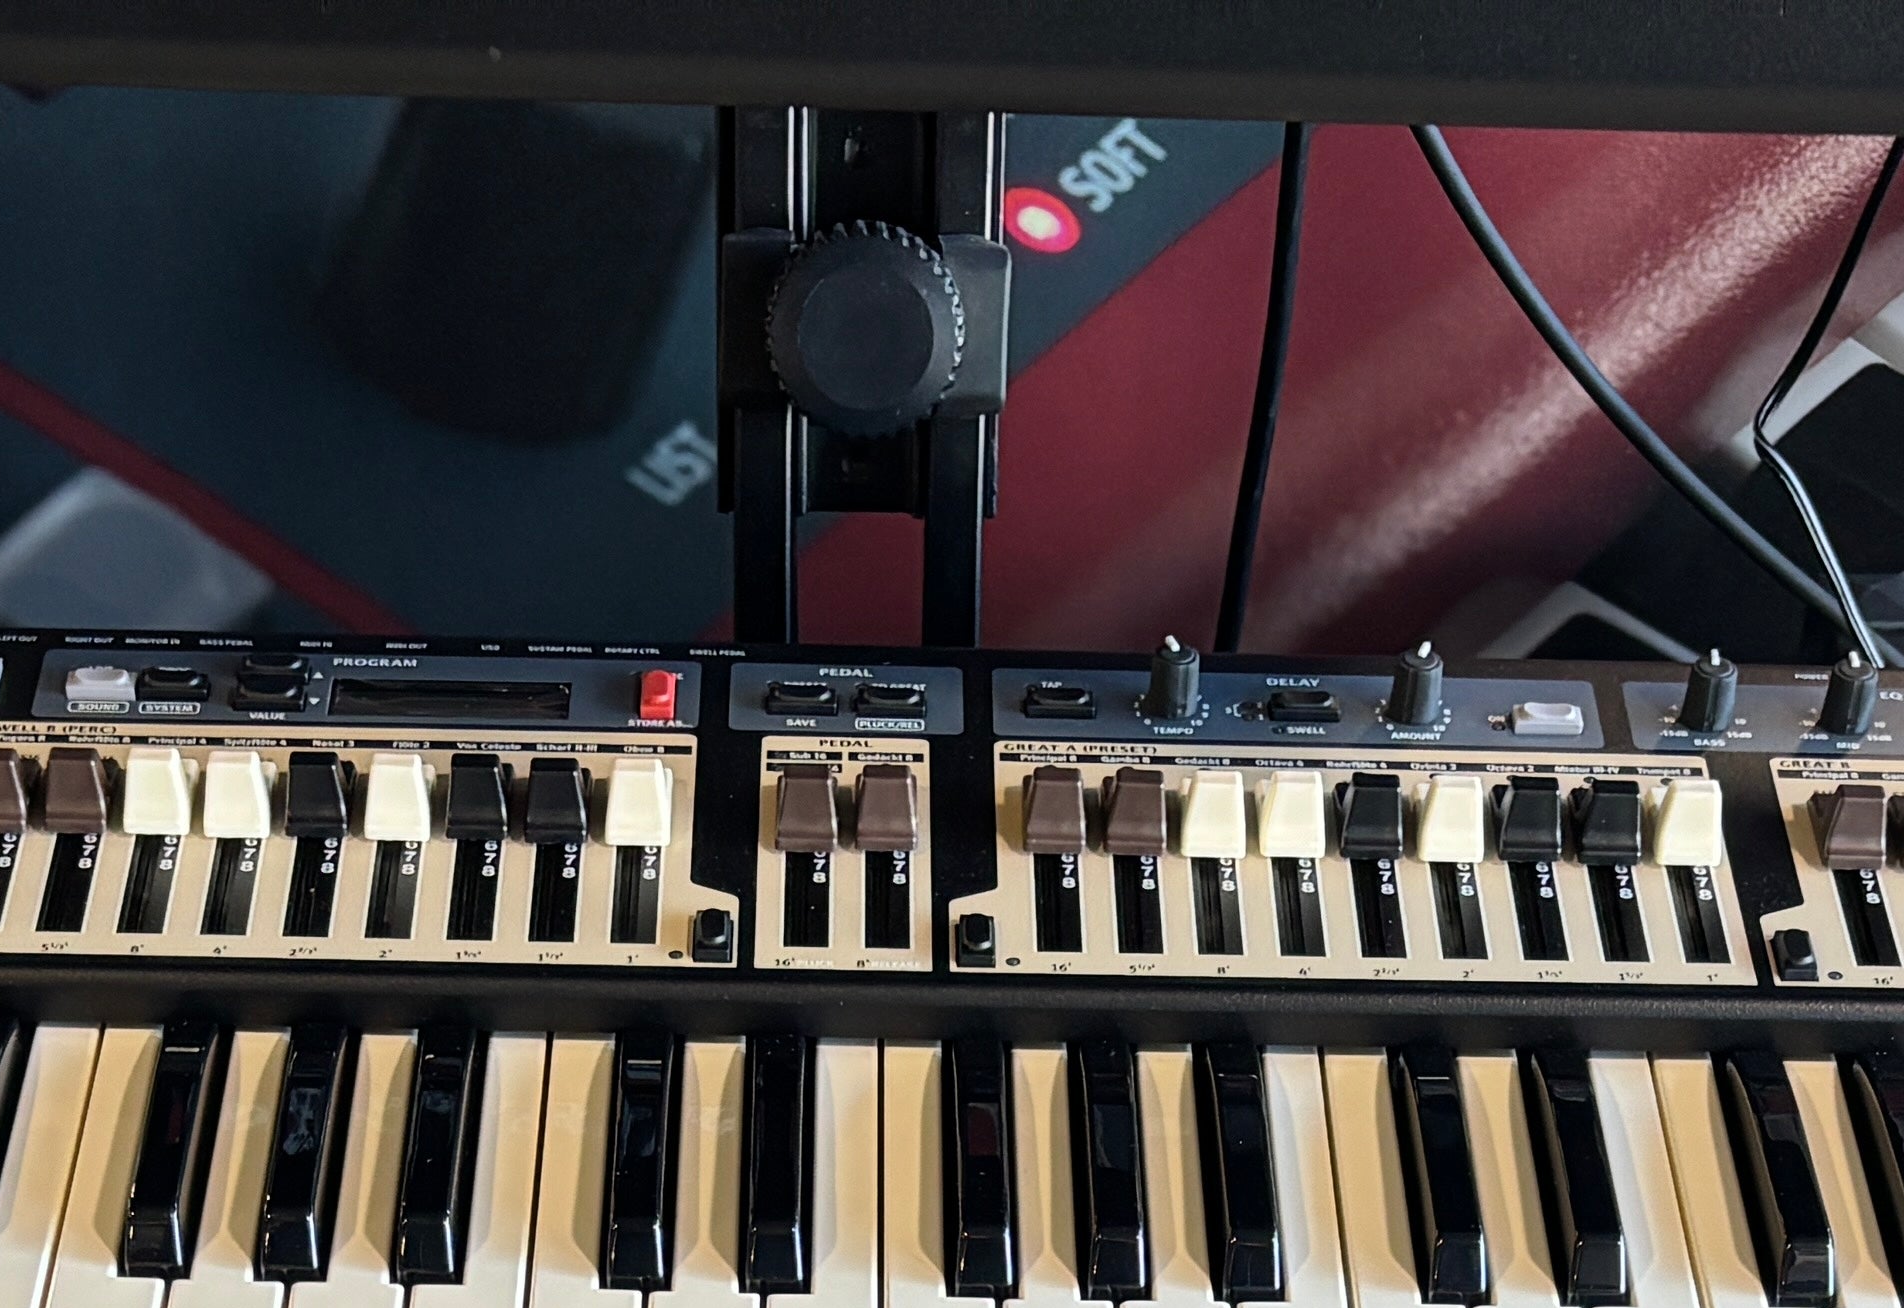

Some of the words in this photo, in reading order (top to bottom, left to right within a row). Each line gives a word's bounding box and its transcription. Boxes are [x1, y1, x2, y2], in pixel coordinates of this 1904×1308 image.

[1058, 117, 1168, 213] SOFT
[333, 657, 417, 668] PROGRAM
[819, 668, 873, 677] PEDAL
[1794, 673, 1829, 681] POWER
[1041, 681, 1063, 689] TAP
[1266, 678, 1320, 688] DELAY
[1879, 691, 1904, 702] EQ
[77, 703, 119, 711] SOUND
[145, 704, 193, 713] SYSTEM
[249, 712, 286, 720] VALUE
[628, 719, 665, 728] STORE
[786, 719, 816, 727] SAVE
[859, 720, 919, 729] PLUCK/REL
[63, 725, 117, 735] (PERC)
[1153, 726, 1193, 735] TEMPO
[1287, 726, 1326, 735] SWELL
[1391, 732, 1441, 741] AMOUNT
[819, 739, 873, 748] PEDAL
[1693, 738, 1725, 747] BASS
[1004, 744, 1060, 752] GREAT
[1066, 744, 1077, 752] A
[1083, 745, 1157, 755] (PRESET)
[789, 752, 811, 760] Sub
[1780, 761, 1832, 769] GREAT
[324, 850, 338, 861] 7
[320, 862, 335, 874] 8
[813, 858, 826, 870] 7
[893, 860, 906, 872] 7
[1062, 864, 1075, 876] 7
[812, 872, 826, 884] 8
[892, 873, 907, 885] 8
[1062, 876, 1076, 889] 8
